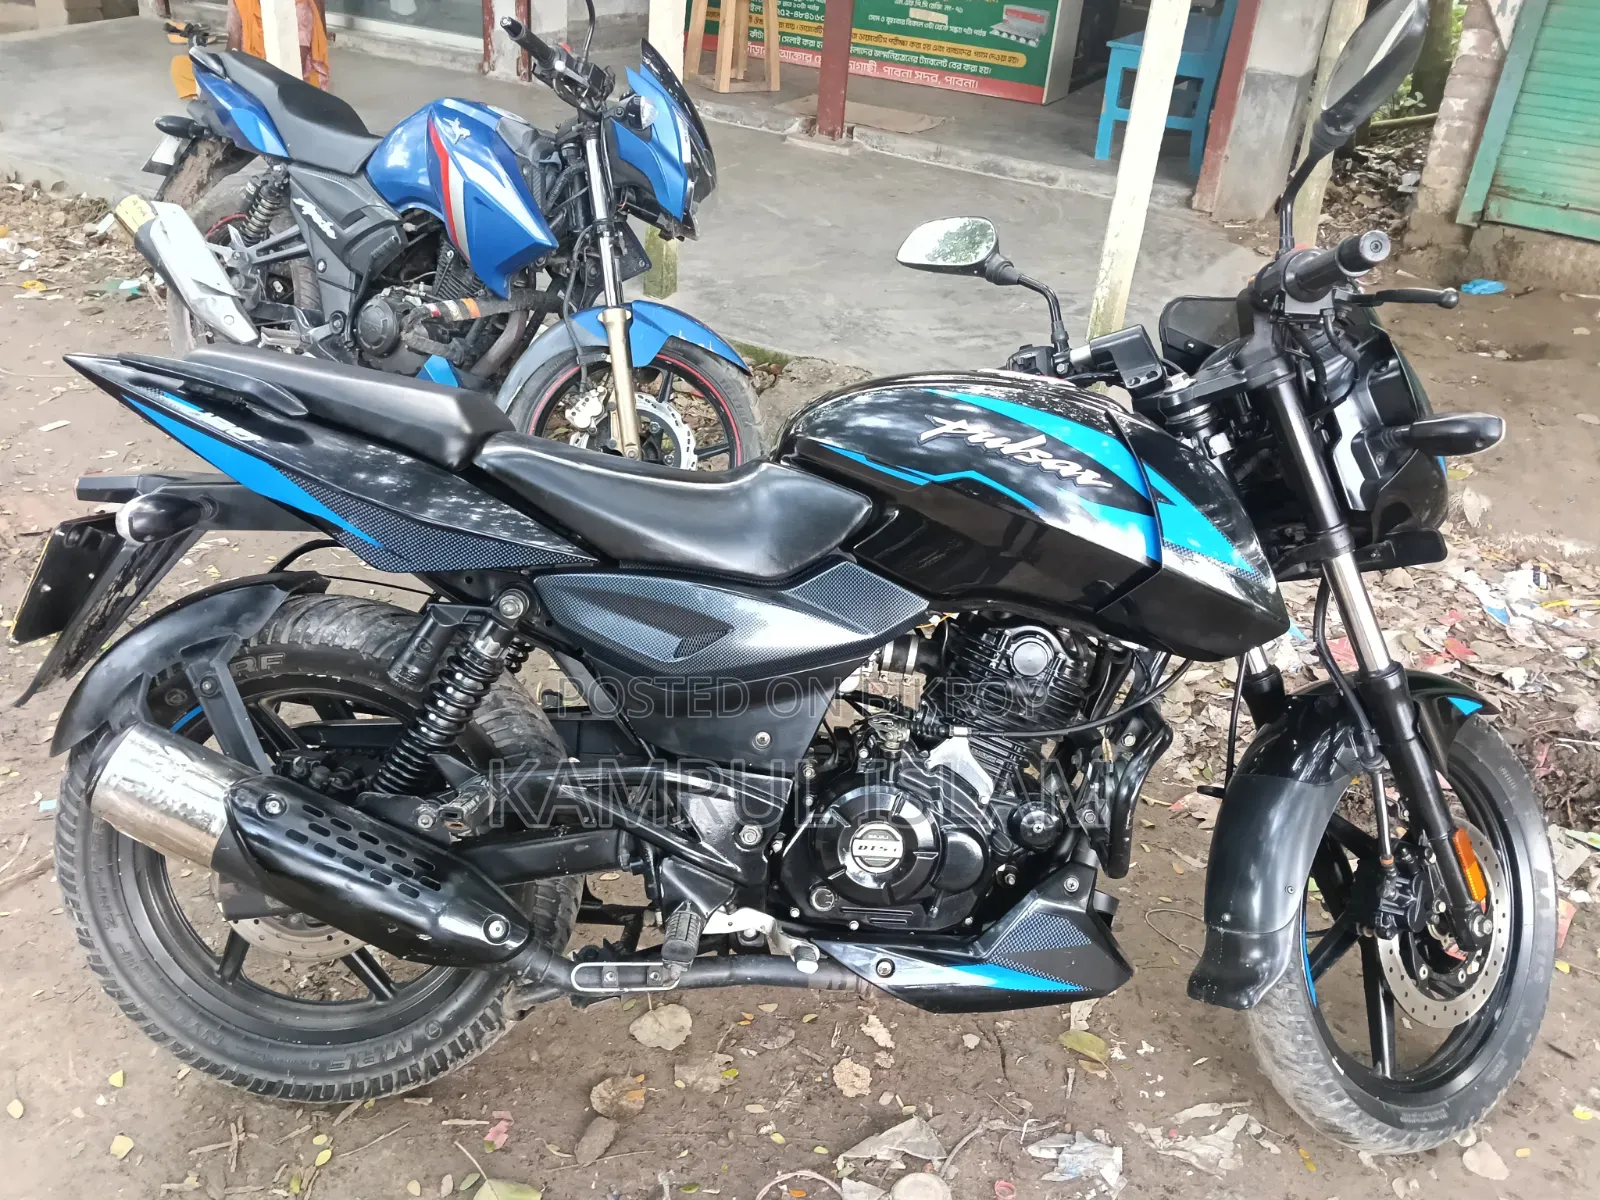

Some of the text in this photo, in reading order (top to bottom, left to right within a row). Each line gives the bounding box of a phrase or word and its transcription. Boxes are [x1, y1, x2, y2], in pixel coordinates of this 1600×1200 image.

[883, 67, 912, 79] পাবনা
[918, 414, 1113, 488] Pulsar
[229, 652, 286, 680] RF
